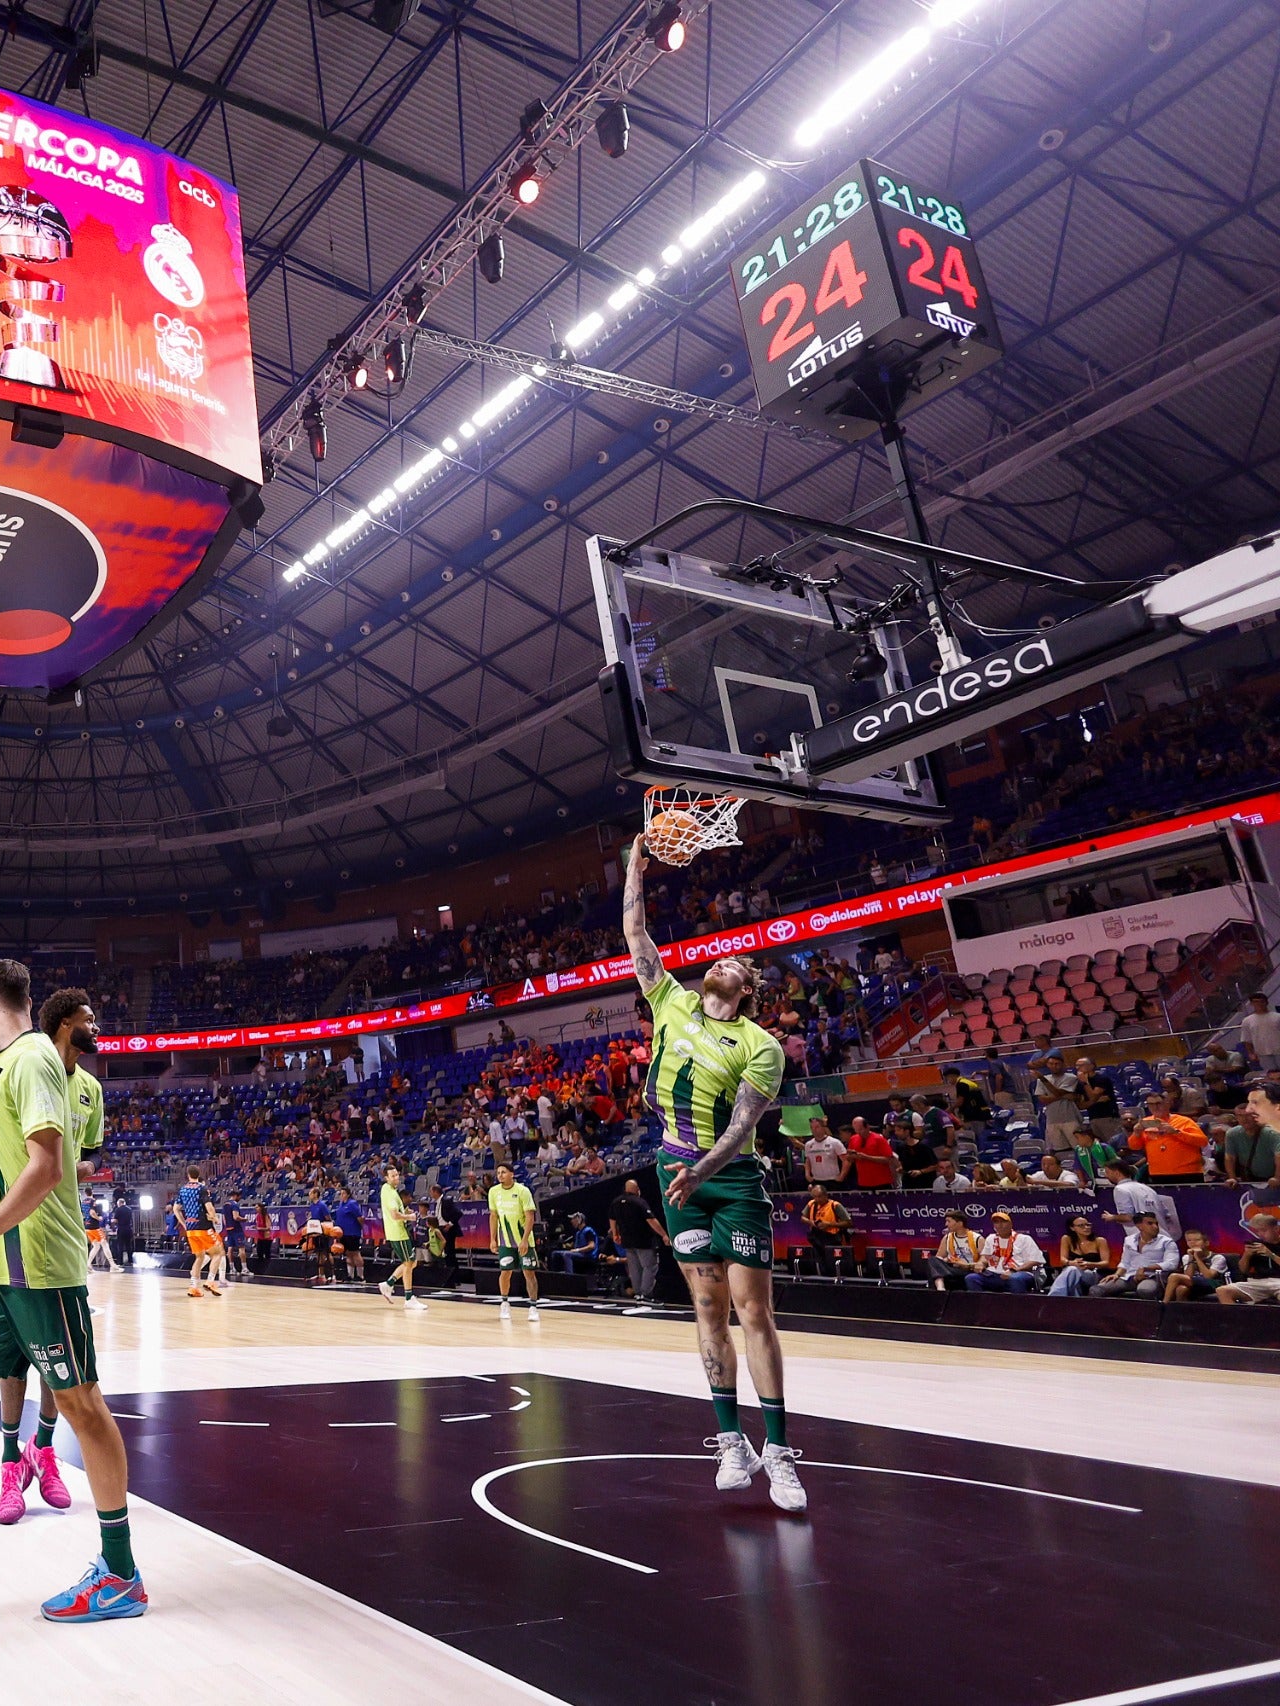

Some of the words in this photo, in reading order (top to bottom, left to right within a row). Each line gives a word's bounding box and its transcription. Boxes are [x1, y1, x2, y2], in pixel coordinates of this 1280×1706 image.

[27, 154, 104, 190] MÁLAGA
[105, 179, 145, 204] 2025
[179, 180, 216, 208] acb
[877, 175, 966, 236] 21:28
[741, 181, 863, 294] 21:28
[897, 227, 978, 309] 24
[760, 240, 867, 362] 24
[926, 308, 974, 338] LOTU
[787, 326, 864, 388] LOTUS
[137, 368, 150, 381] La
[153, 373, 189, 399] Laguna
[190, 387, 226, 415] Tenerife
[853, 639, 1054, 743] endesa
[811, 904, 883, 928] mediolanum
[1127, 912, 1158, 923] Ciudad
[1143, 918, 1174, 930] Málaga
[685, 932, 756, 961] endesa
[1019, 930, 1075, 950] málaga
[559, 971, 576, 980] Ciudad
[97, 1040, 120, 1051] esa
[207, 1033, 232, 1044] pelayo
[772, 1209, 789, 1222] cb
[902, 1204, 955, 1218] endesa
[1000, 1205, 1049, 1214] mediolanum
[1060, 1204, 1093, 1215] pelayo
[732, 1241, 757, 1257] laga
